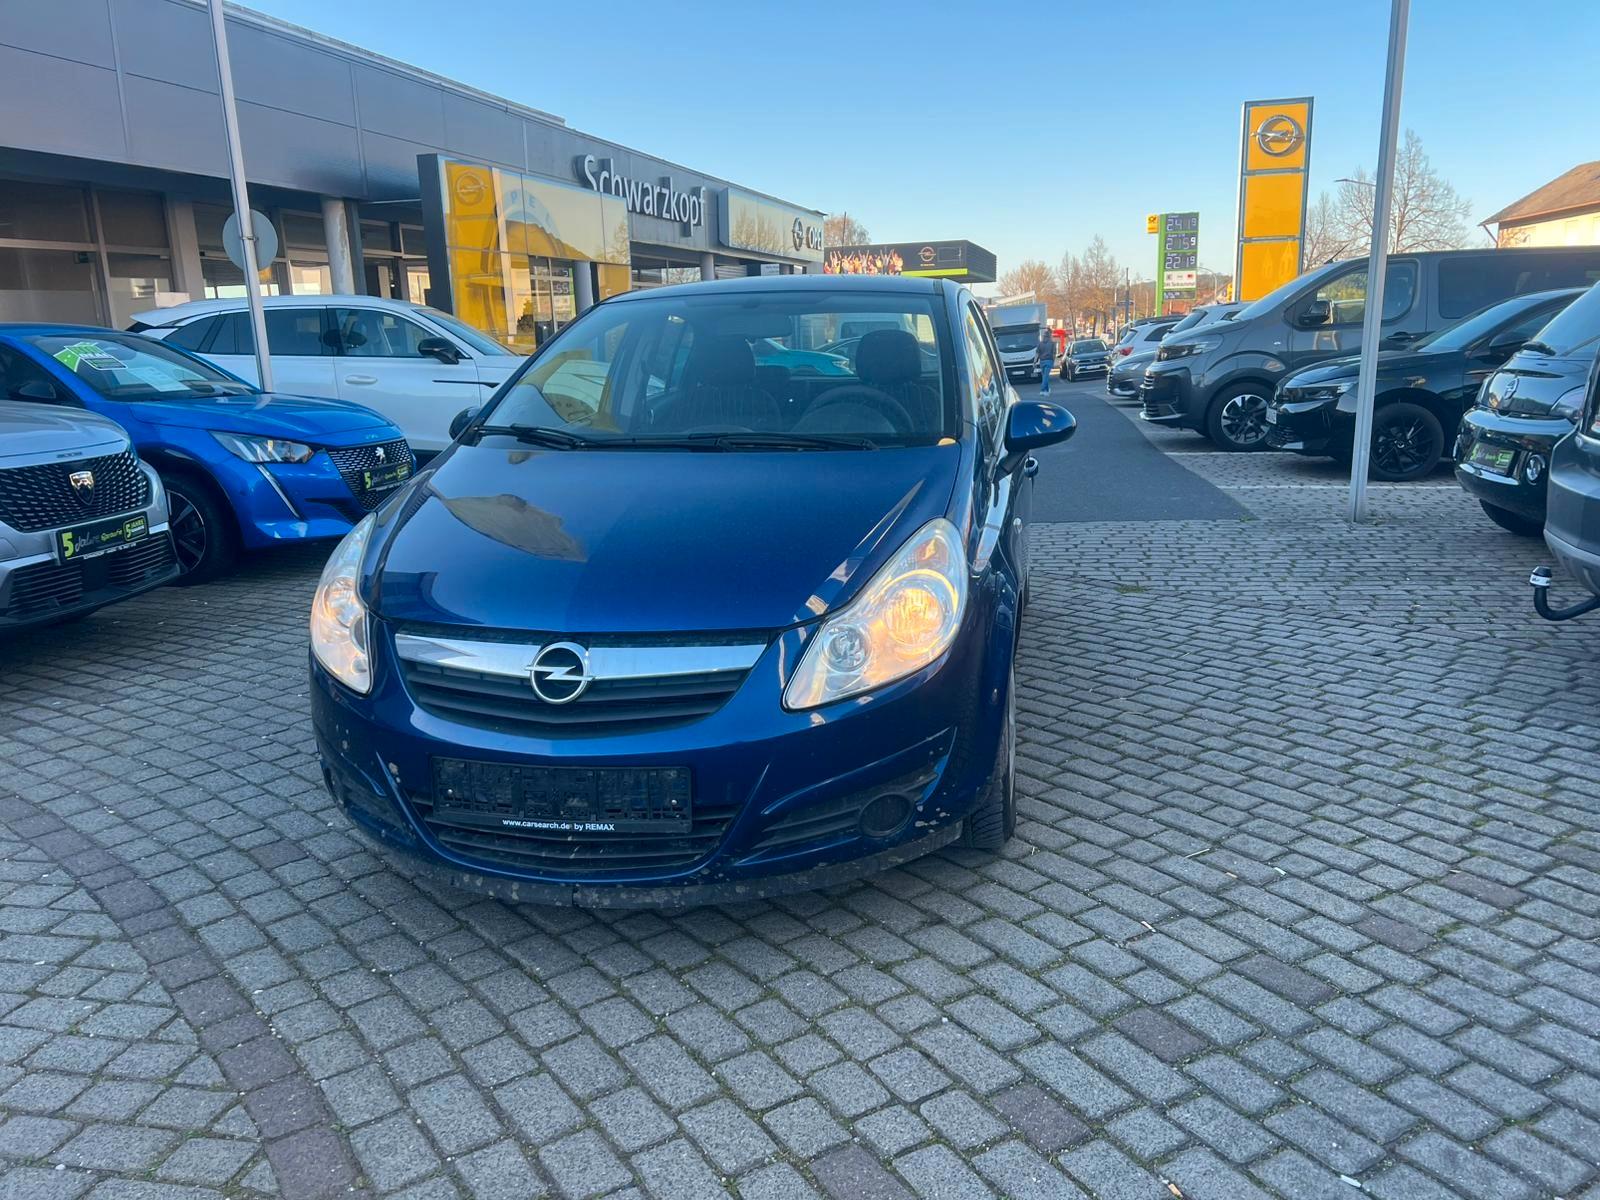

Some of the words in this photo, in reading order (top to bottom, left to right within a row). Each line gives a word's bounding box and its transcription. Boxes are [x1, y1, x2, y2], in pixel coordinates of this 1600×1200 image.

[583, 154, 706, 237] Schwarzkopf
[125, 523, 132, 539] 5
[61, 531, 74, 557] 5
[502, 819, 570, 830] www.carsearch.de
[574, 823, 584, 831] by
[585, 823, 615, 831] REMAX
